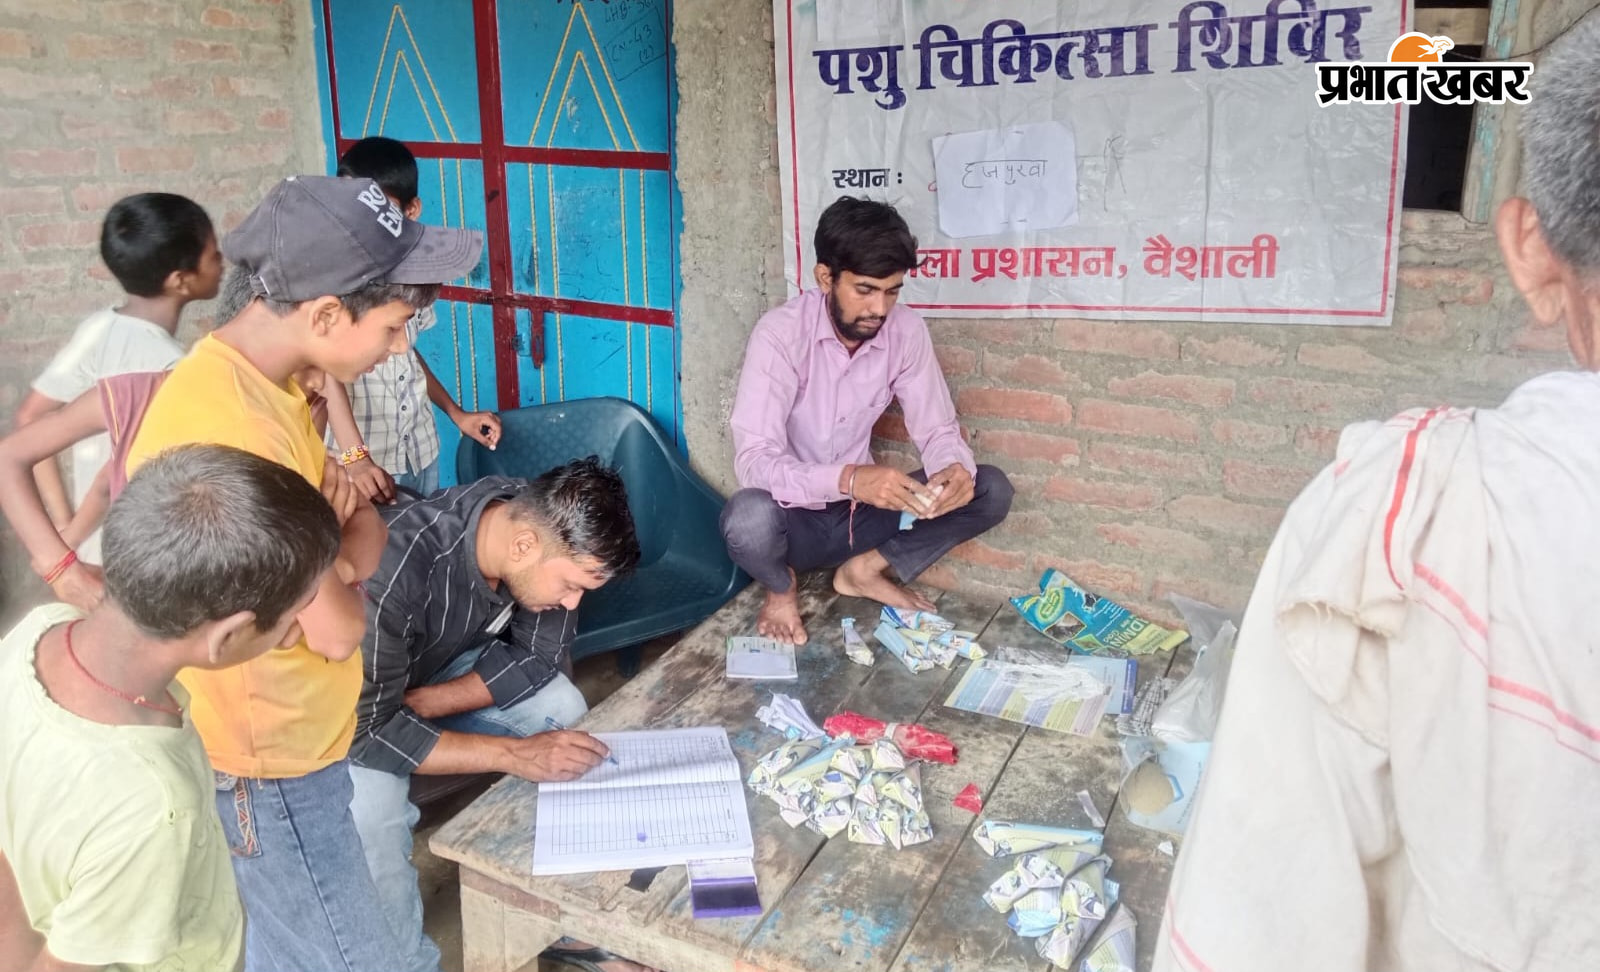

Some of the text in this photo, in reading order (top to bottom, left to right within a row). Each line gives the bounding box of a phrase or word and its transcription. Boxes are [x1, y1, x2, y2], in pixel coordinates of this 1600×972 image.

[812, 0, 1372, 110] पशु चिकित्सा शिविर
[832, 168, 890, 188] स्थान
[357, 181, 387, 213] RO
[377, 202, 403, 238] EN
[910, 233, 1280, 283] ला प्रशासन, वैशाली
